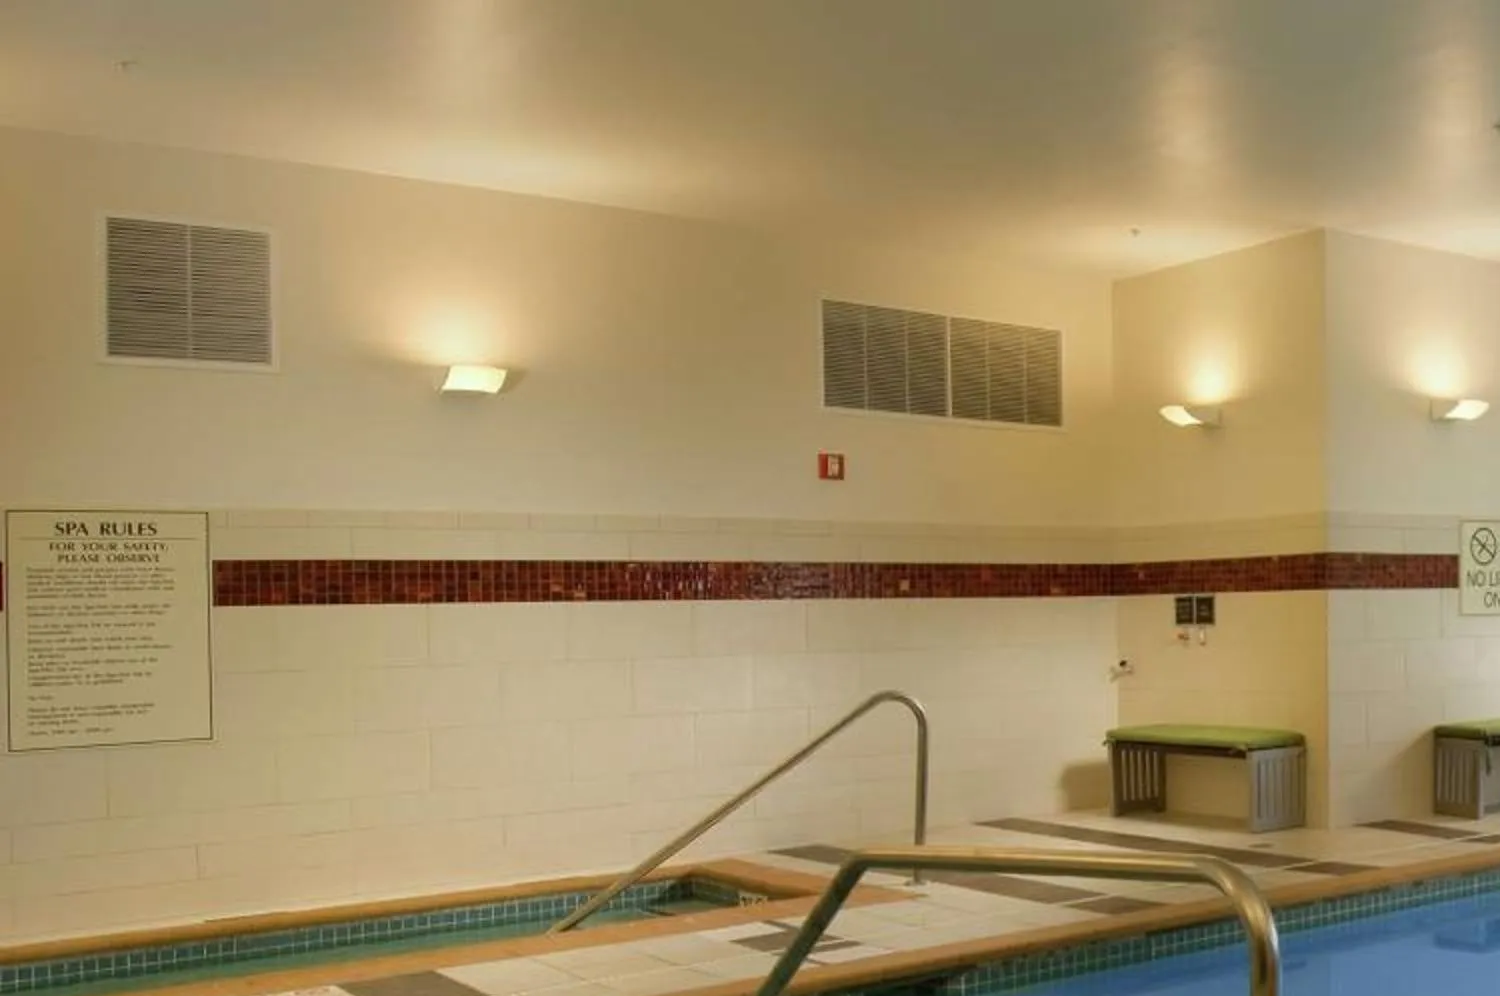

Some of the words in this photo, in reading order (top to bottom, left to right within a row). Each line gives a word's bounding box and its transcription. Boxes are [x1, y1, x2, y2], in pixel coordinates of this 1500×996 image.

[54, 521, 89, 537] SPA
[99, 521, 158, 537] RULES
[49, 541, 75, 552] FOR
[57, 553, 100, 564] PLEASE
[106, 553, 160, 563] OBSERVE
[1466, 569, 1486, 588] NO
